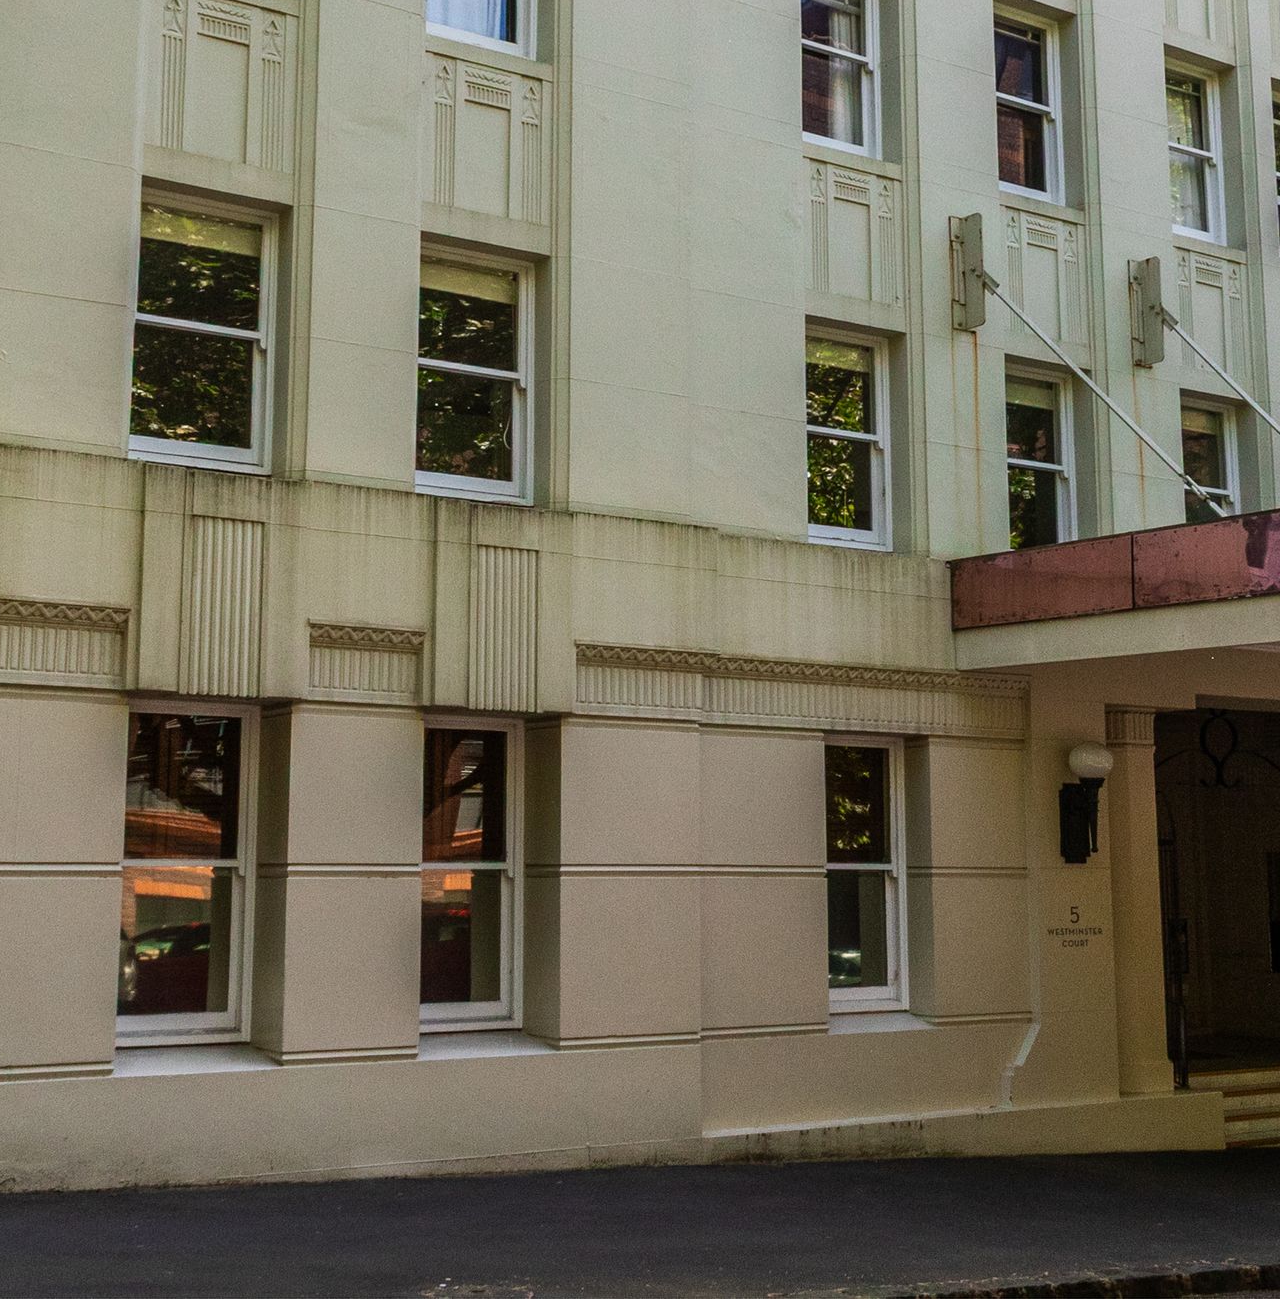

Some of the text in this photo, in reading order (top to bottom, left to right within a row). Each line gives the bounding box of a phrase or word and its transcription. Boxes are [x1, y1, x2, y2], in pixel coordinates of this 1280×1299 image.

[1070, 905, 1080, 924] 5
[1047, 927, 1104, 936] WESTMINSTER
[1062, 939, 1088, 948] COURT
